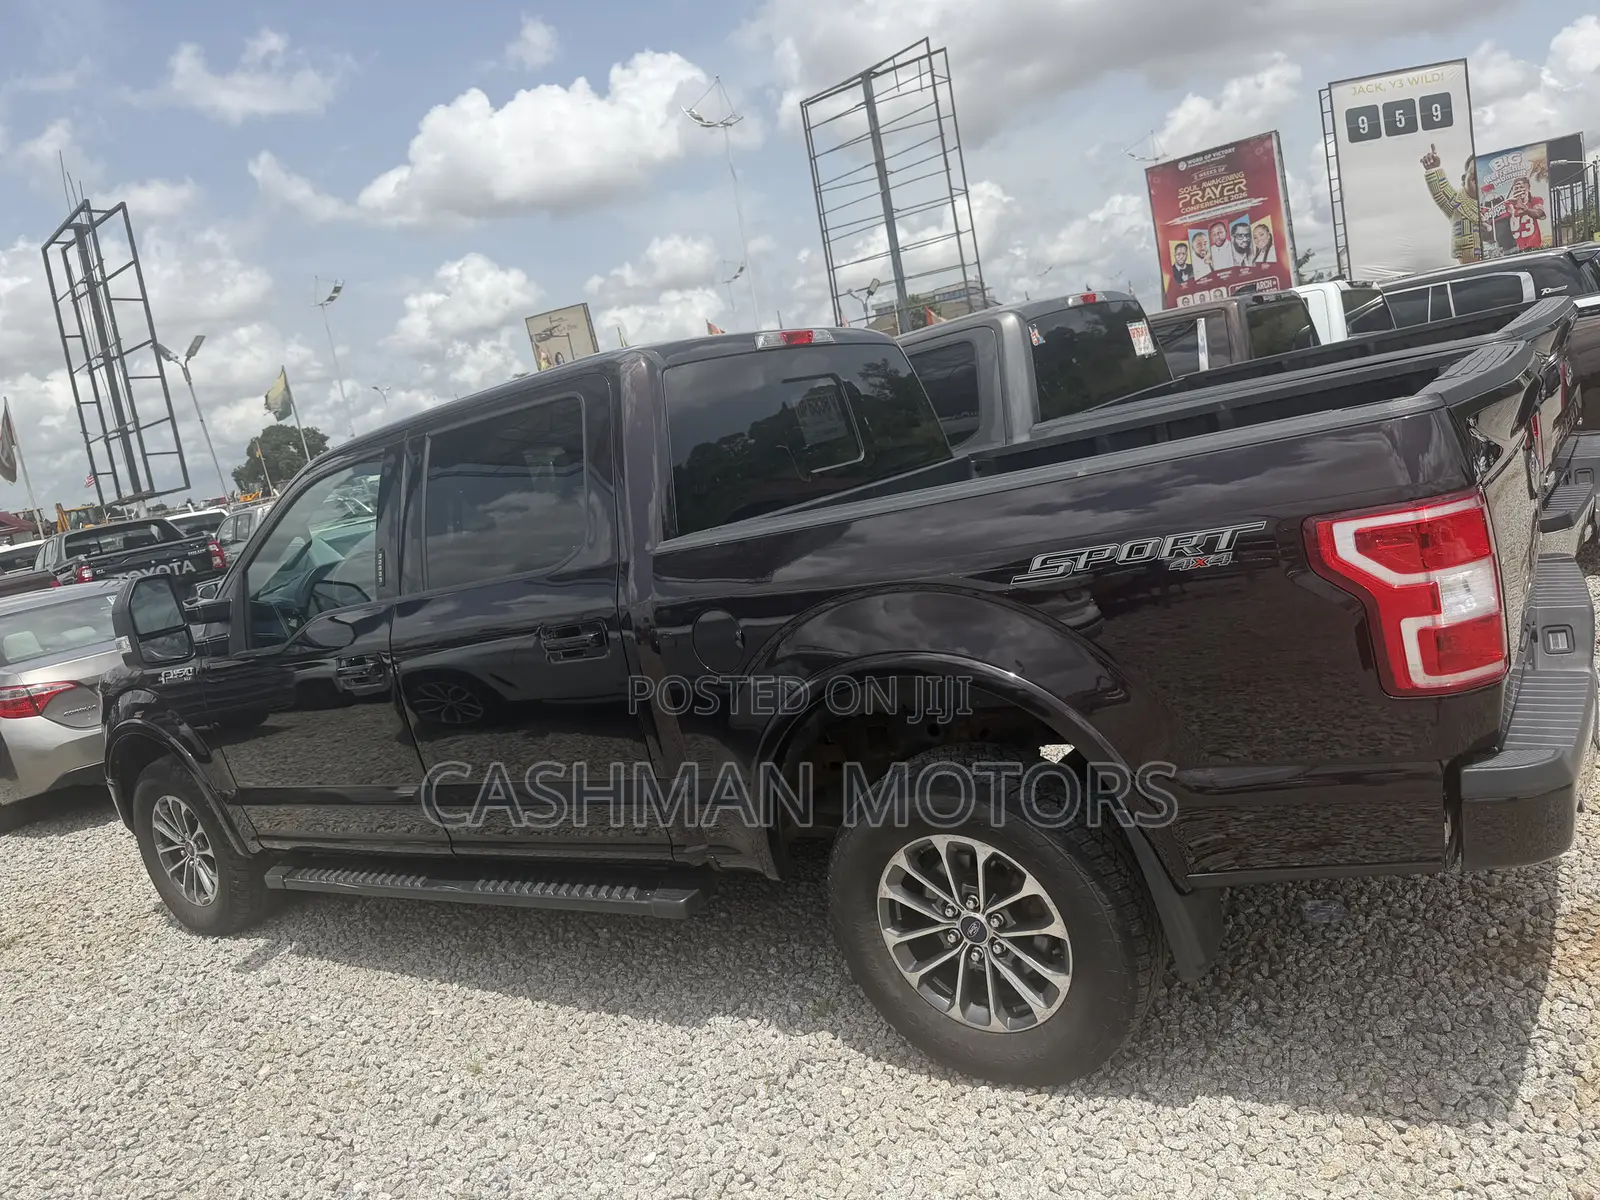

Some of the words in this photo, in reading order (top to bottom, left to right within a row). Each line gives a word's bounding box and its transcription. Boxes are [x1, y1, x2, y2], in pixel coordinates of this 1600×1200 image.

[1351, 83, 1387, 96] JACK,
[1389, 79, 1404, 89] Y3
[1407, 72, 1444, 86] WILD!
[1358, 115, 1369, 134] 9
[1395, 109, 1406, 128] 5
[1431, 103, 1442, 122] 9
[1187, 155, 1203, 165] WORD
[1212, 147, 1236, 158] VICTORY
[1490, 151, 1523, 171] BIG
[1178, 184, 1200, 195] SOUL
[1201, 171, 1245, 189] AWAKENING
[1198, 169, 1217, 178] WEEKS
[1177, 178, 1248, 209] PRAYER
[1181, 197, 1229, 214] CONFERENCE
[1230, 192, 1248, 201] 2026
[1010, 520, 1267, 585] SPORT
